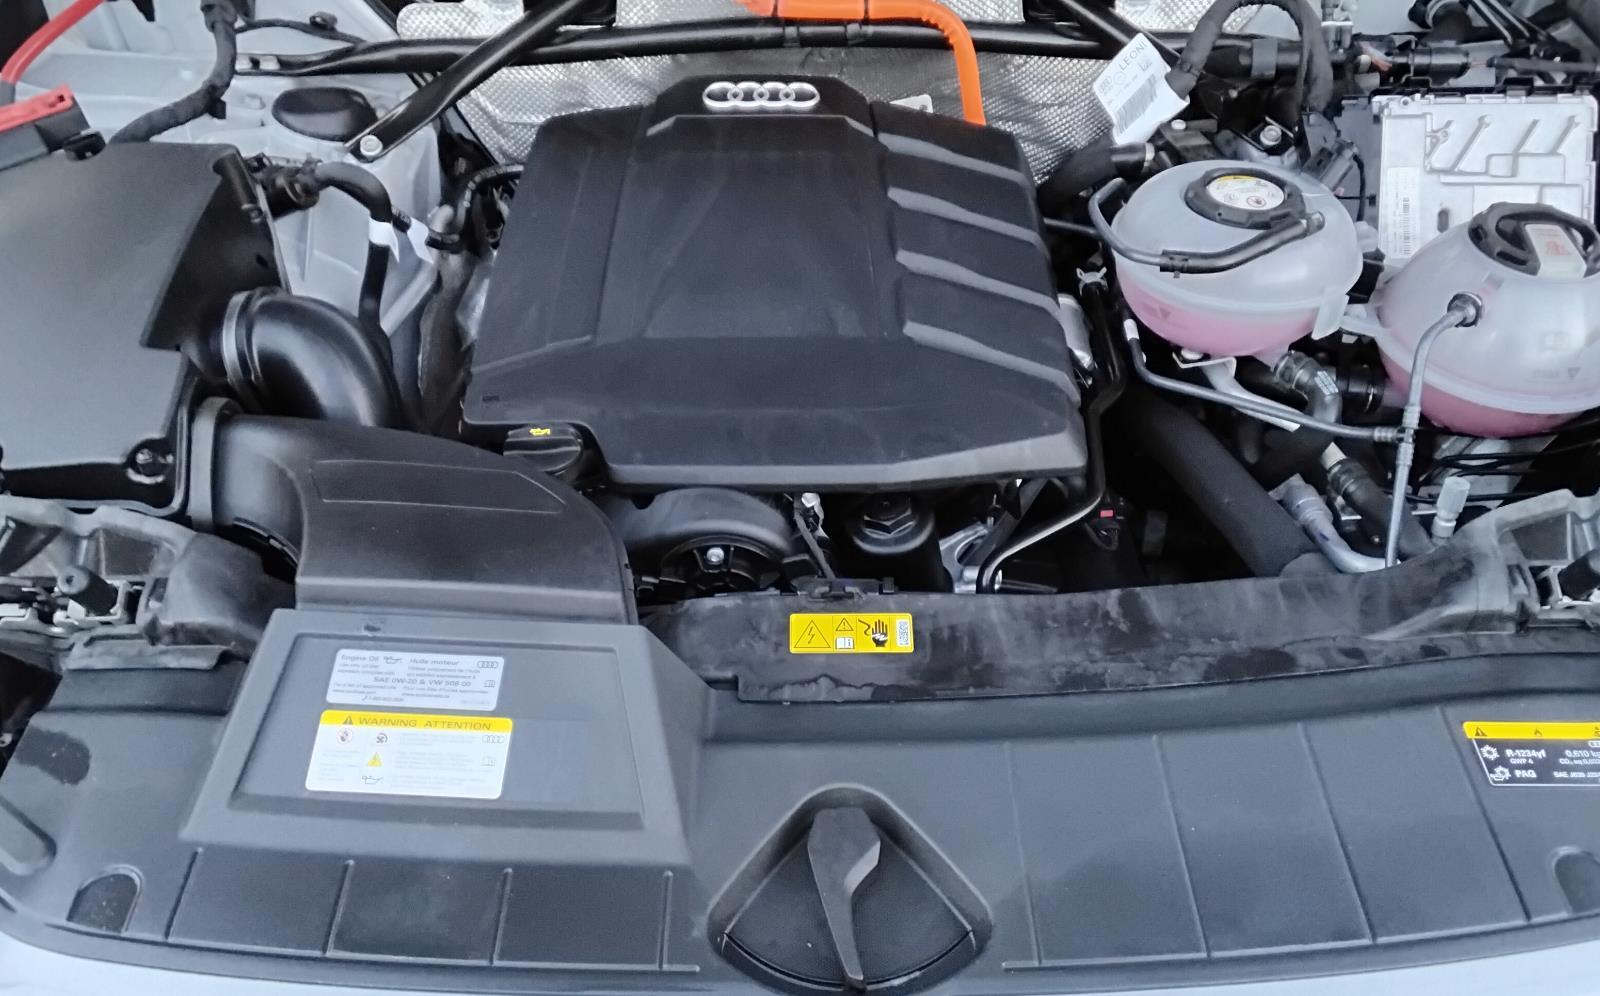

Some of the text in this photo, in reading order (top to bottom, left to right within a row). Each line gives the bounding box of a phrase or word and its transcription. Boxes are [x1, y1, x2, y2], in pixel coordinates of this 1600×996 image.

[1119, 40, 1148, 71] LEONI
[341, 654, 367, 663] Engine
[359, 716, 492, 731] WARNING ATTENTION
[1505, 749, 1546, 758] R-1234yf
[1514, 769, 1537, 778] PAG
